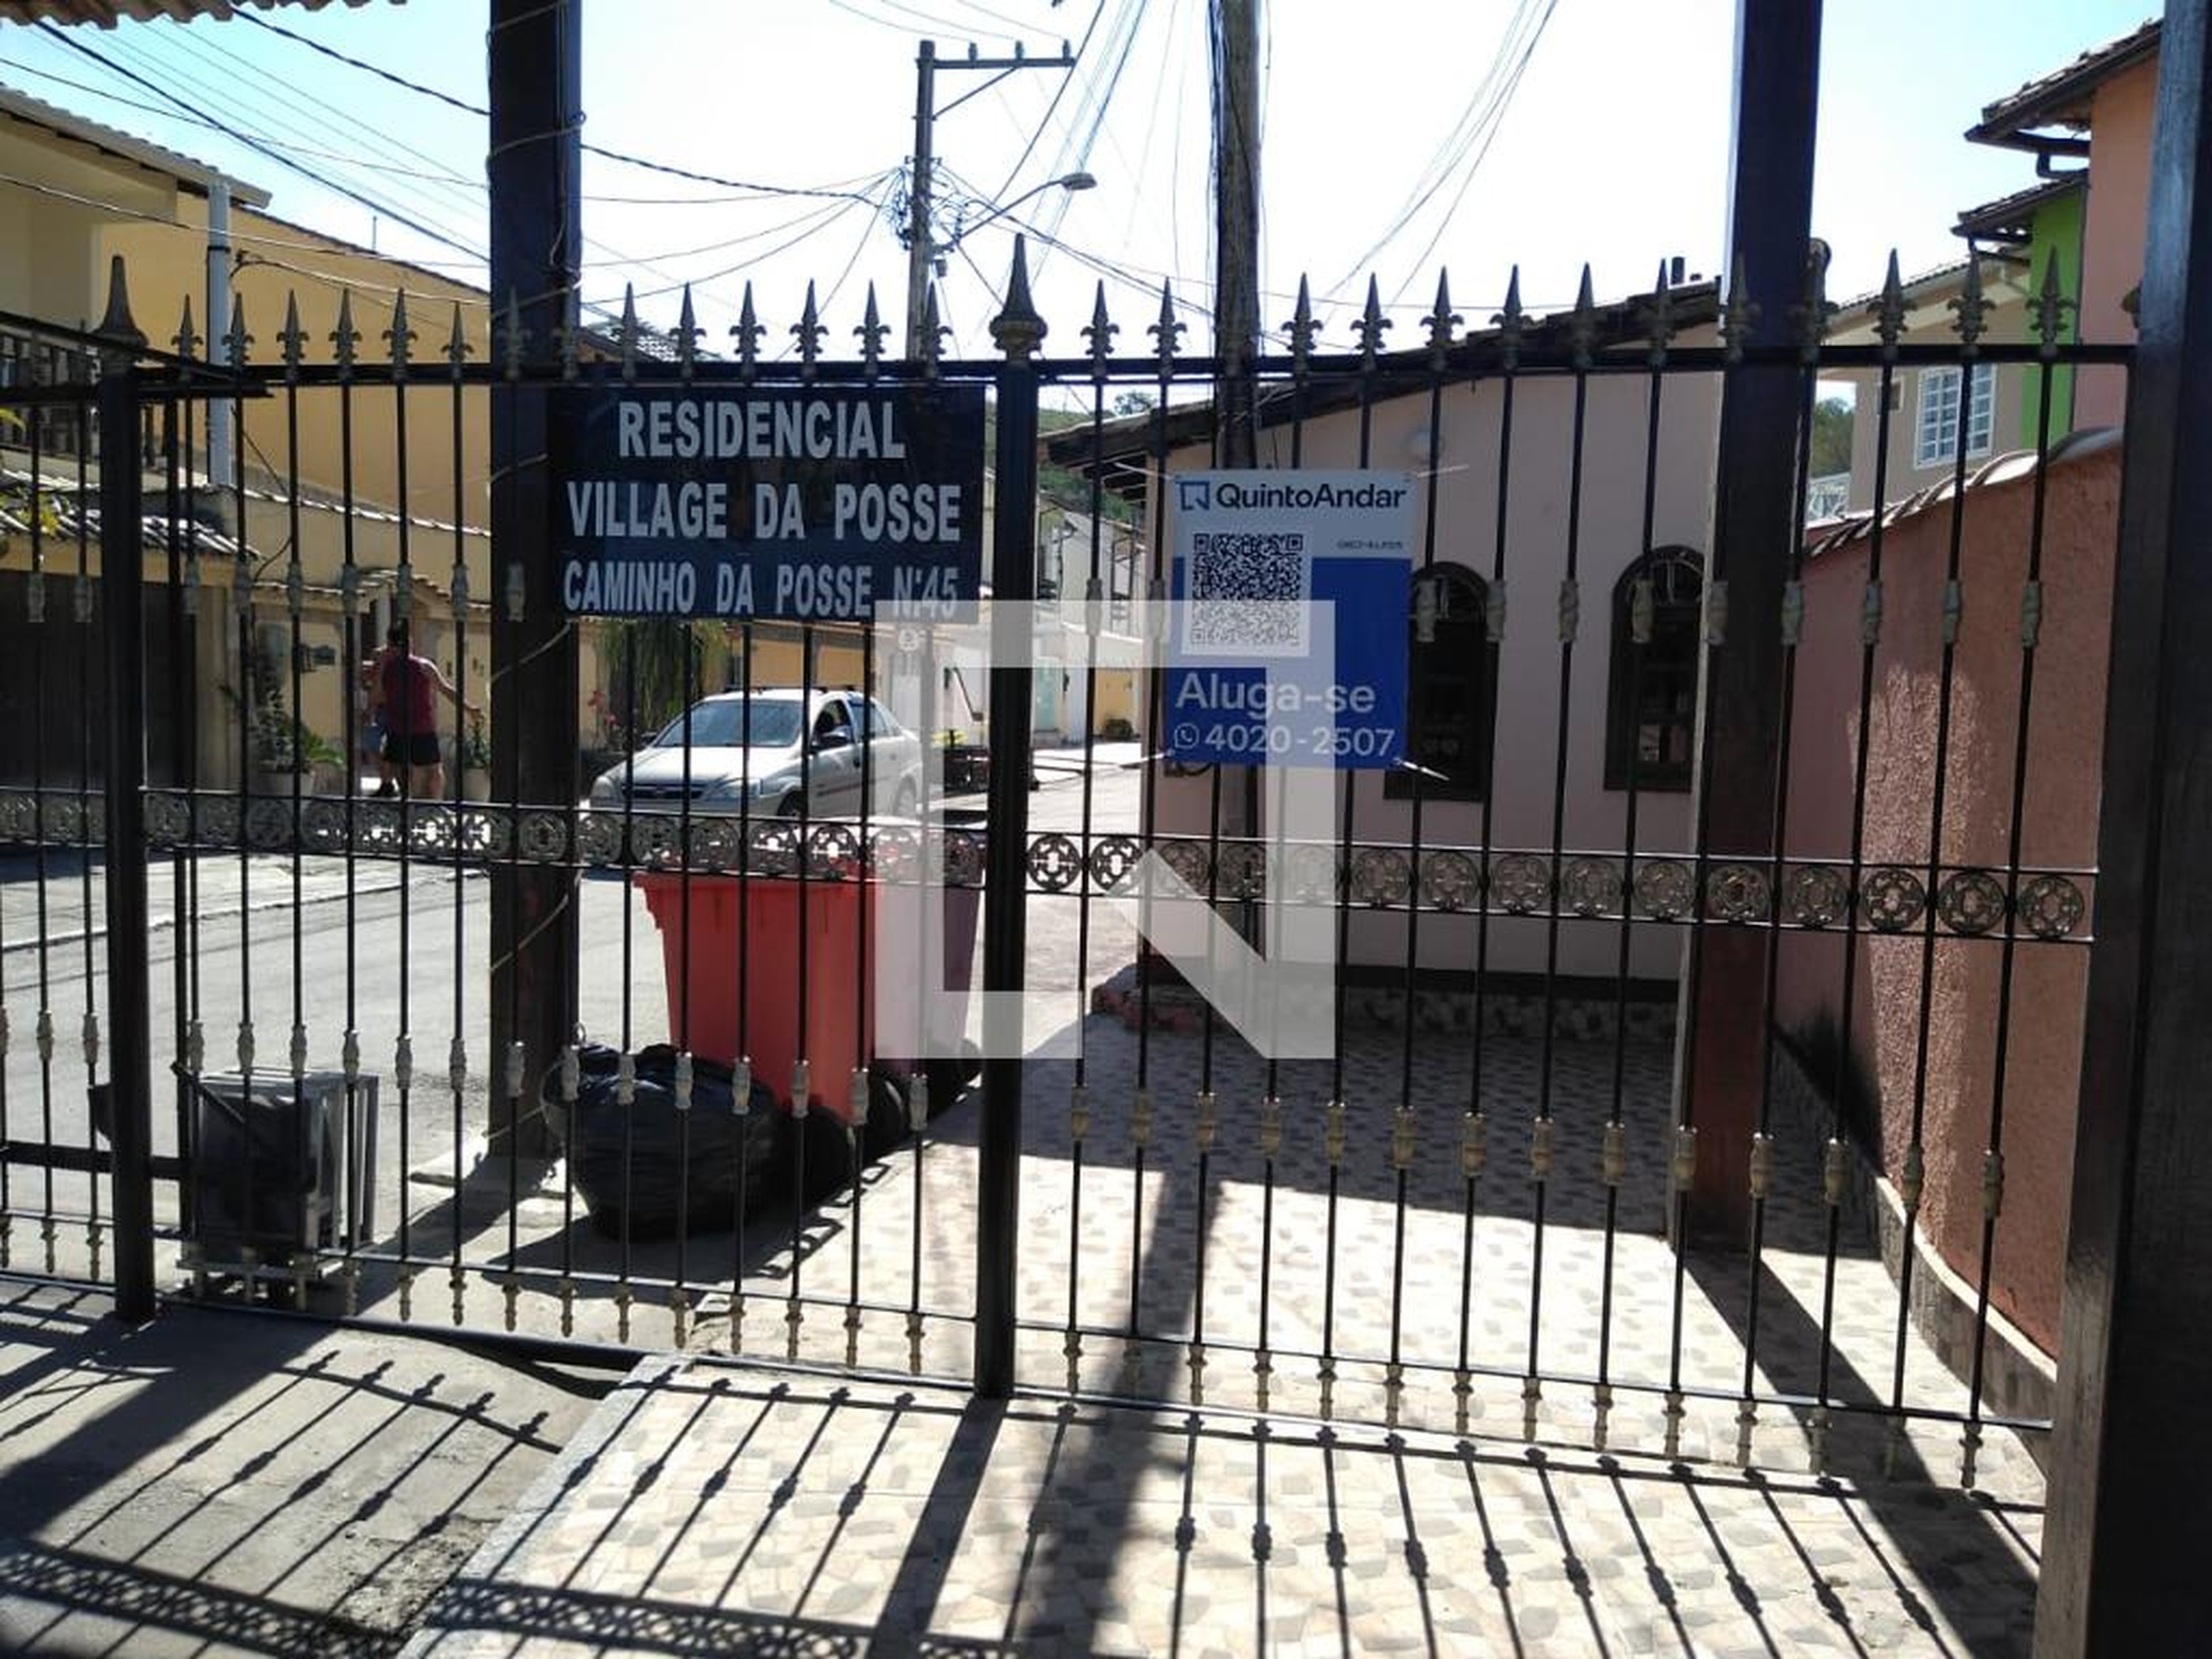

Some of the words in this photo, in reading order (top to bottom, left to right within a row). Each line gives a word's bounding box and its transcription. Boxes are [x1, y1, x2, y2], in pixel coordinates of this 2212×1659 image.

[619, 400, 906, 459] RESIDENCIAL
[567, 480, 728, 539] VILLAGE
[755, 483, 805, 539] DA
[834, 483, 961, 542] POSSE
[1215, 483, 1407, 509] QuintoAndar
[564, 560, 695, 613] CAMINHO
[716, 562, 754, 615] DA
[776, 564, 872, 618] POSSE
[1175, 672, 1376, 719] Aluga-se
